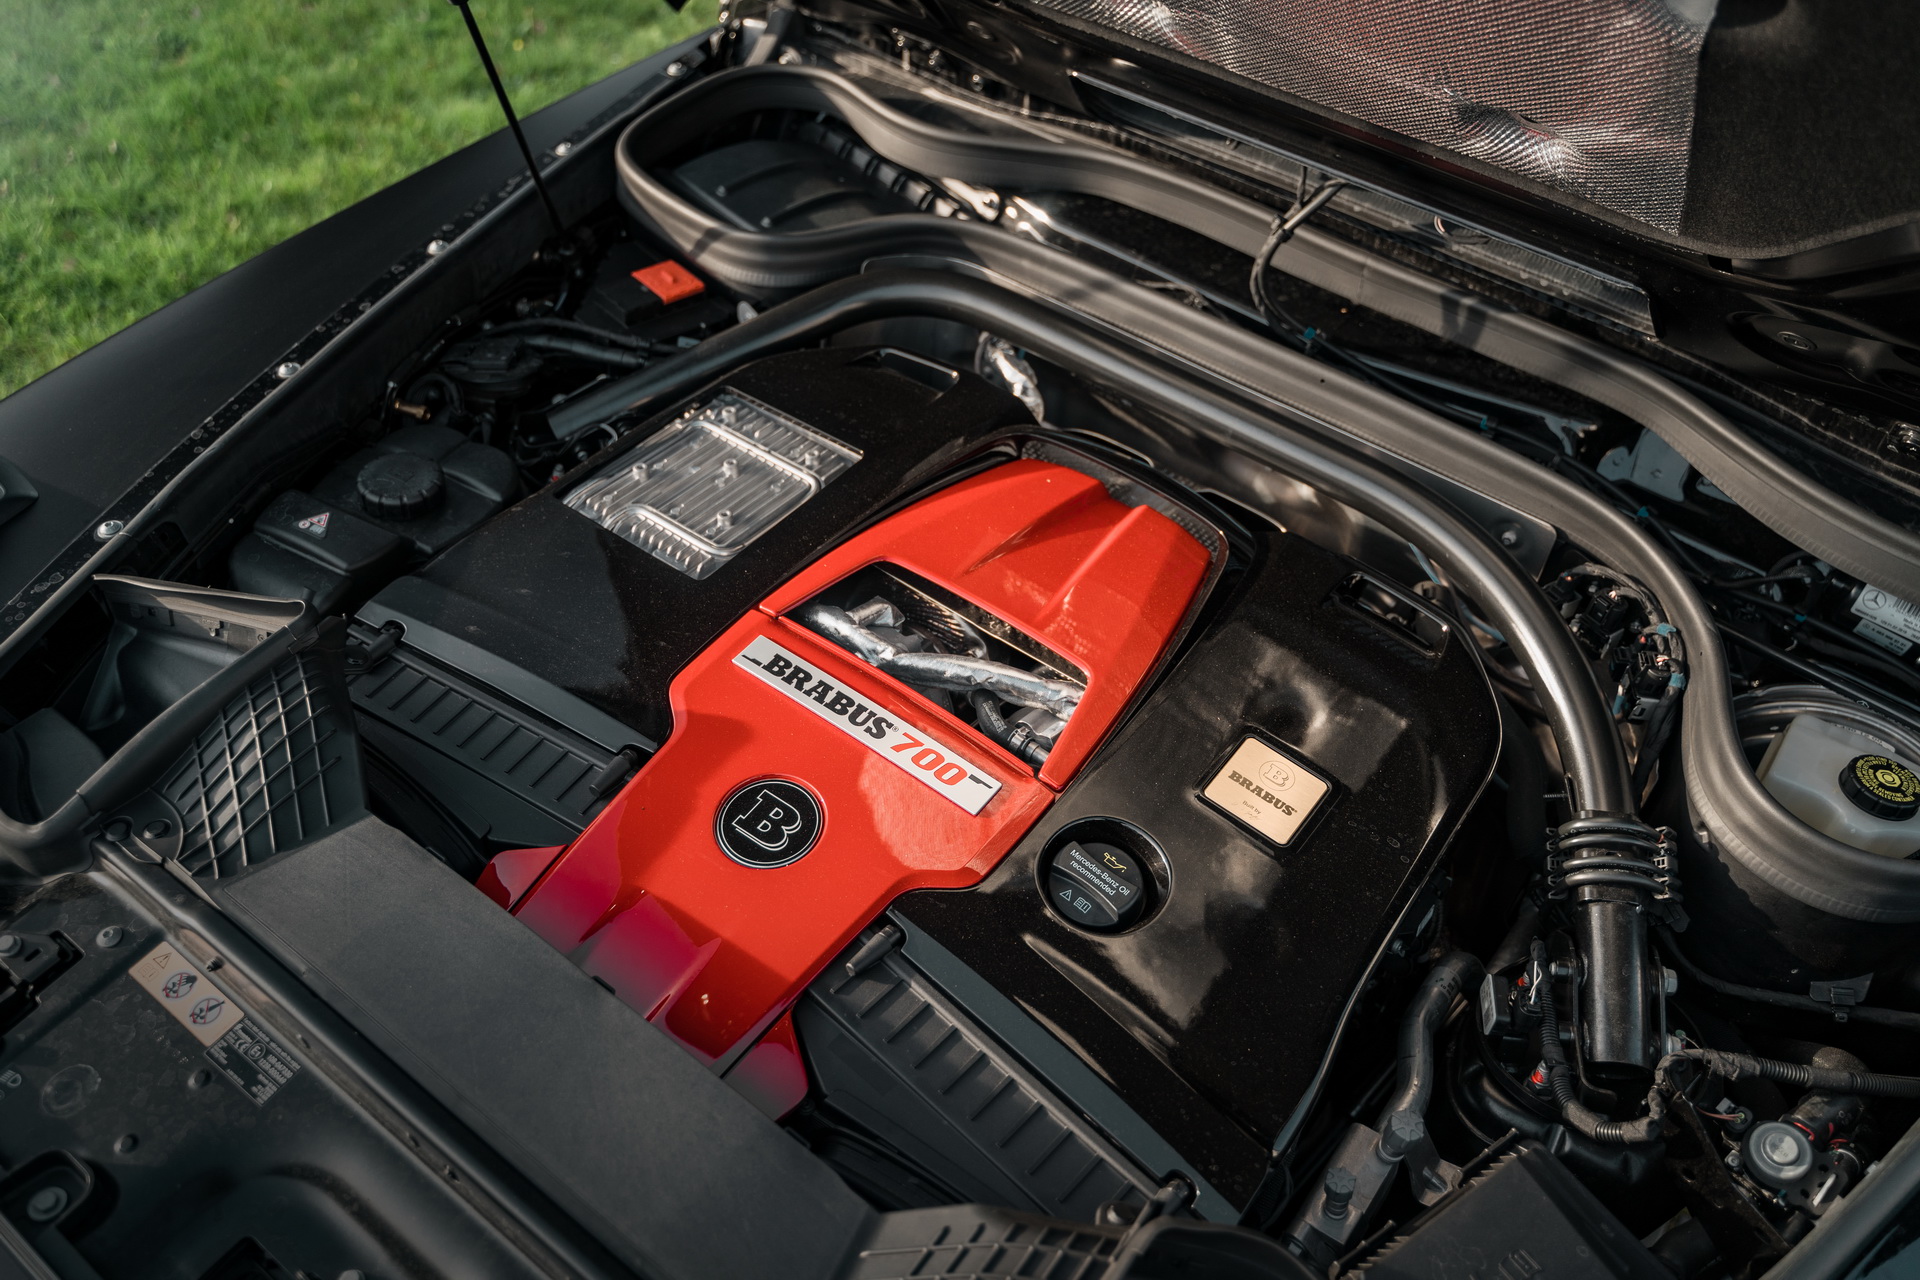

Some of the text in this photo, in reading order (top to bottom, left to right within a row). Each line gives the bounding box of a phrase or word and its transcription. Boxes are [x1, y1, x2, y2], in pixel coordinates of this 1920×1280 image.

[761, 653, 968, 786] BRABUS 700
[1228, 770, 1296, 816] BRABUS
[1263, 763, 1290, 787] B
[732, 789, 802, 851] B
[1070, 849, 1130, 896] Mercedes-Benz Oil
[1070, 860, 1116, 896] recommended
